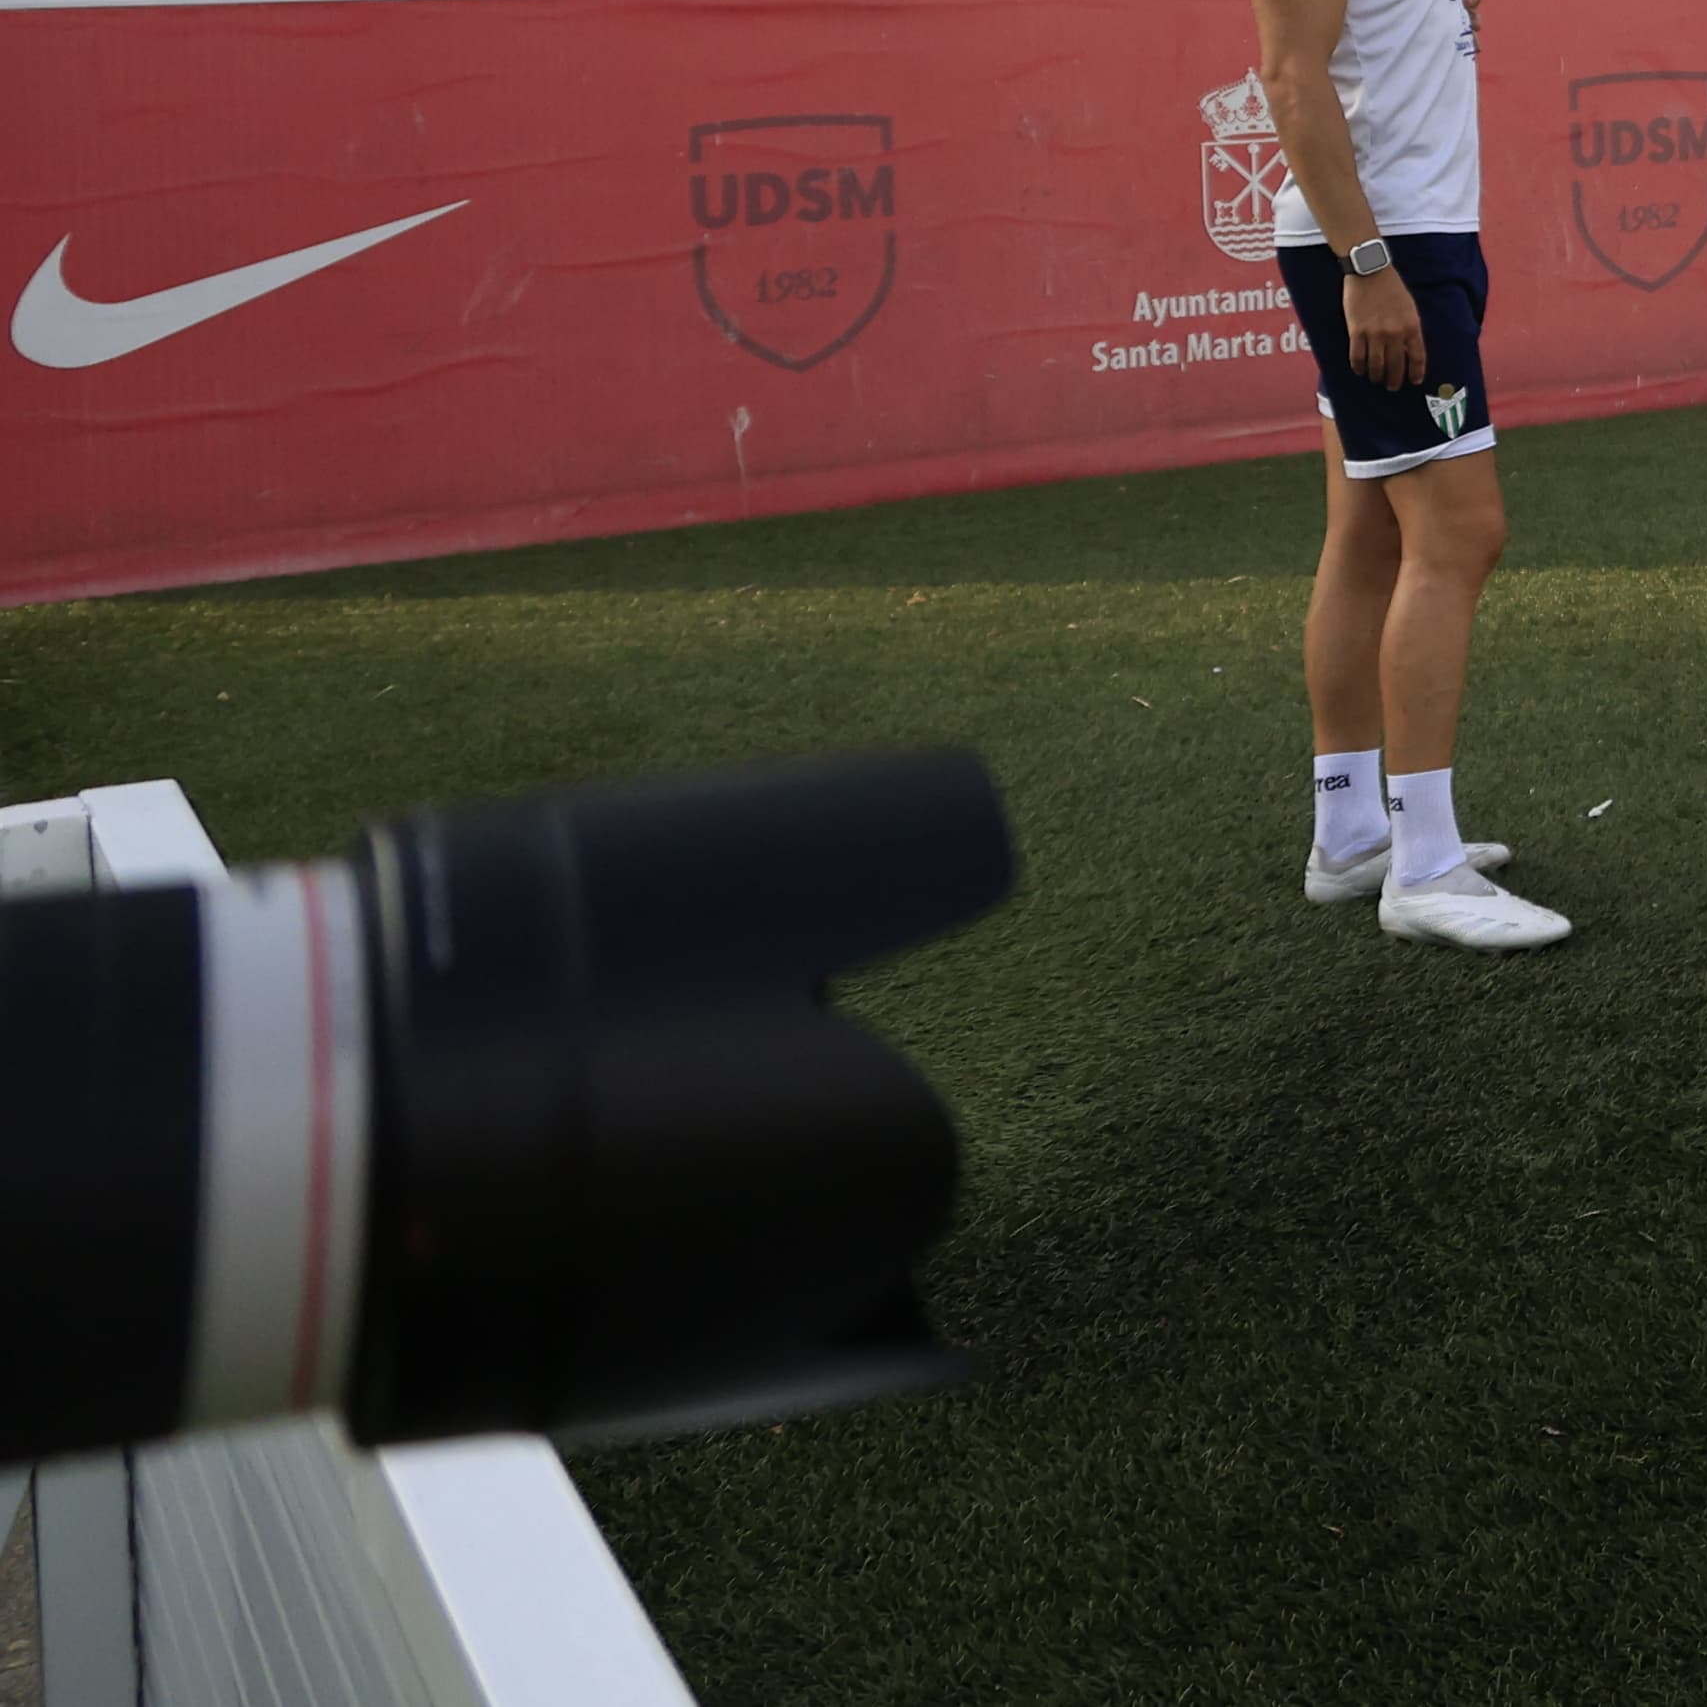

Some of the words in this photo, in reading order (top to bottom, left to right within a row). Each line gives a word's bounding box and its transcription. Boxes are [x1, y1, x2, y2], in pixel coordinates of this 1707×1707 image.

[690, 164, 896, 230] UDSM
[1617, 202, 1680, 232] 1982
[757, 267, 839, 304] 1982
[1133, 280, 1290, 328] Ayuntamie
[1091, 340, 1179, 372] Santa
[1187, 328, 1274, 363] Marta
[1315, 774, 1351, 792] rea
